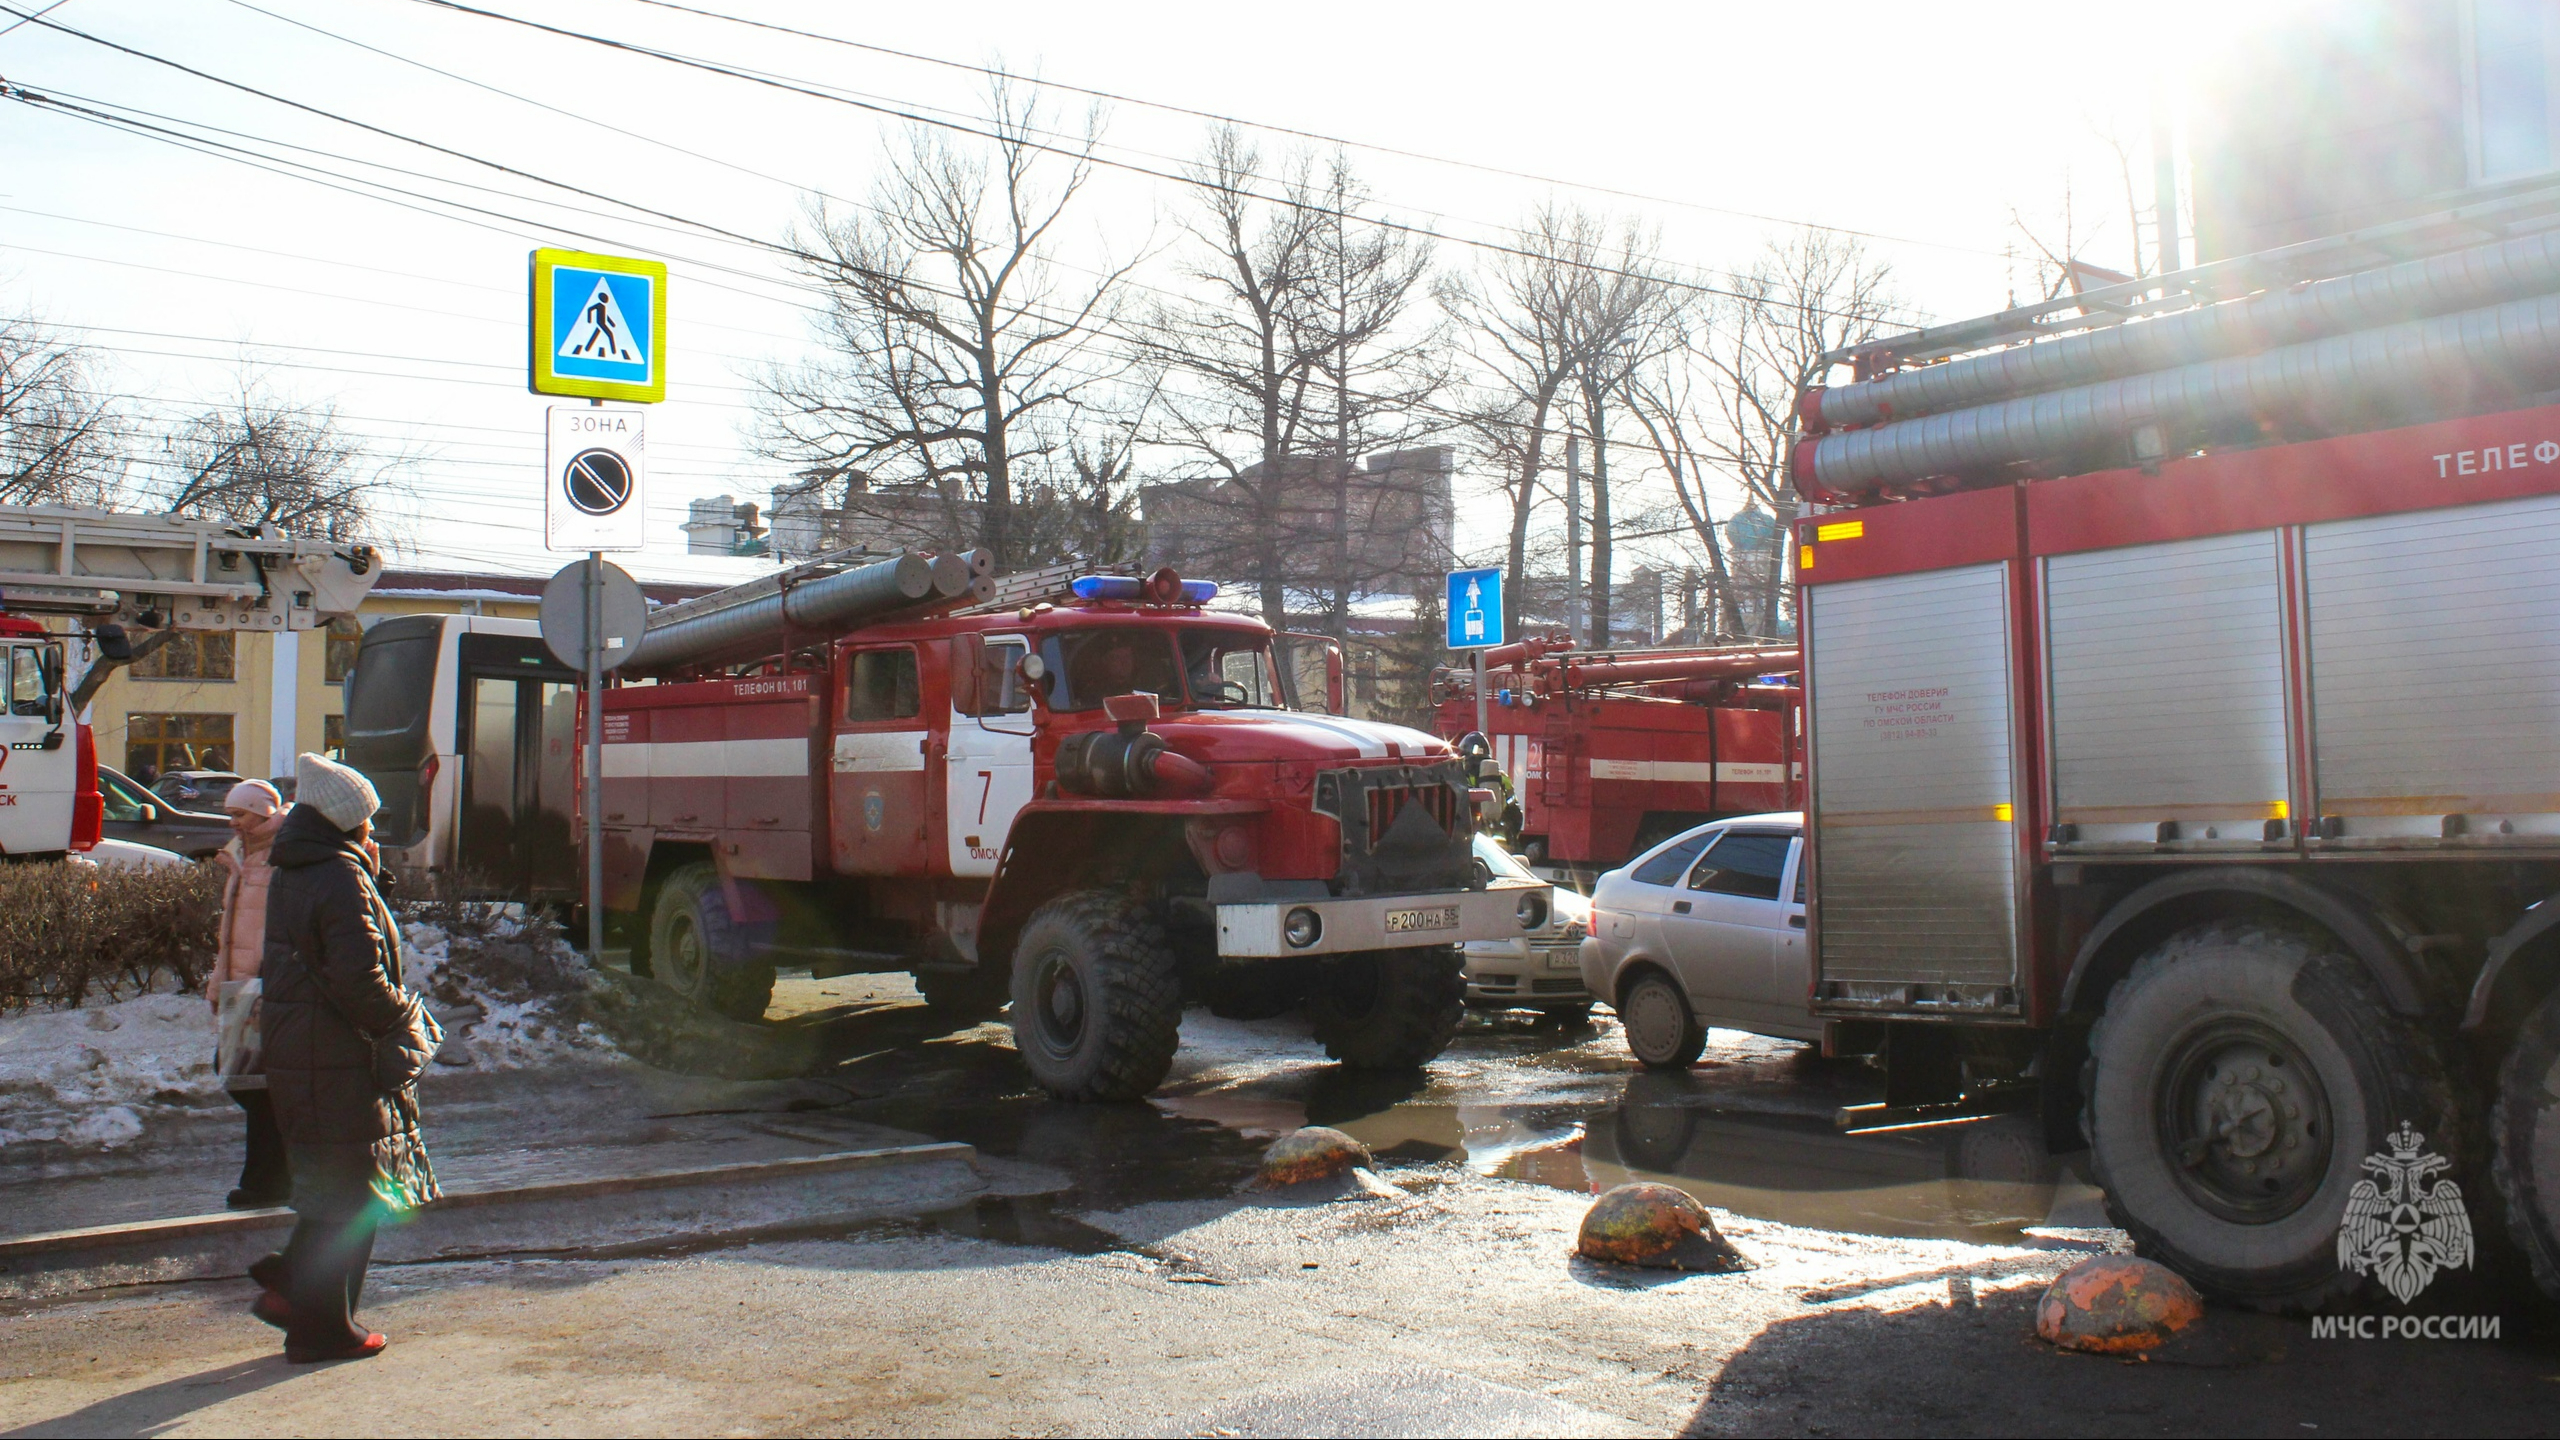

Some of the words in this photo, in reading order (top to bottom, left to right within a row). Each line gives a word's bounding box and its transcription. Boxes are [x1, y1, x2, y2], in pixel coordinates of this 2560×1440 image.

[570, 416, 627, 433] ЗОНА
[2433, 440, 2560, 478] ТЕЛЕФ
[733, 682, 775, 696] ТЕЛЕФОН
[776, 680, 790, 694] 01,
[792, 679, 807, 691] 101
[1867, 690, 1906, 702] ТЕЛЕФОН
[1908, 688, 1949, 700] ДОВЕРИЯ
[1886, 704, 1904, 714] МЧС
[1906, 702, 1942, 712] РОССИИ
[1863, 719, 1876, 728] ПО
[1914, 714, 1955, 725] ОБЛАСТИ
[978, 771, 992, 825] 7
[970, 848, 999, 860] ОМСК
[1444, 908, 1456, 921] 55
